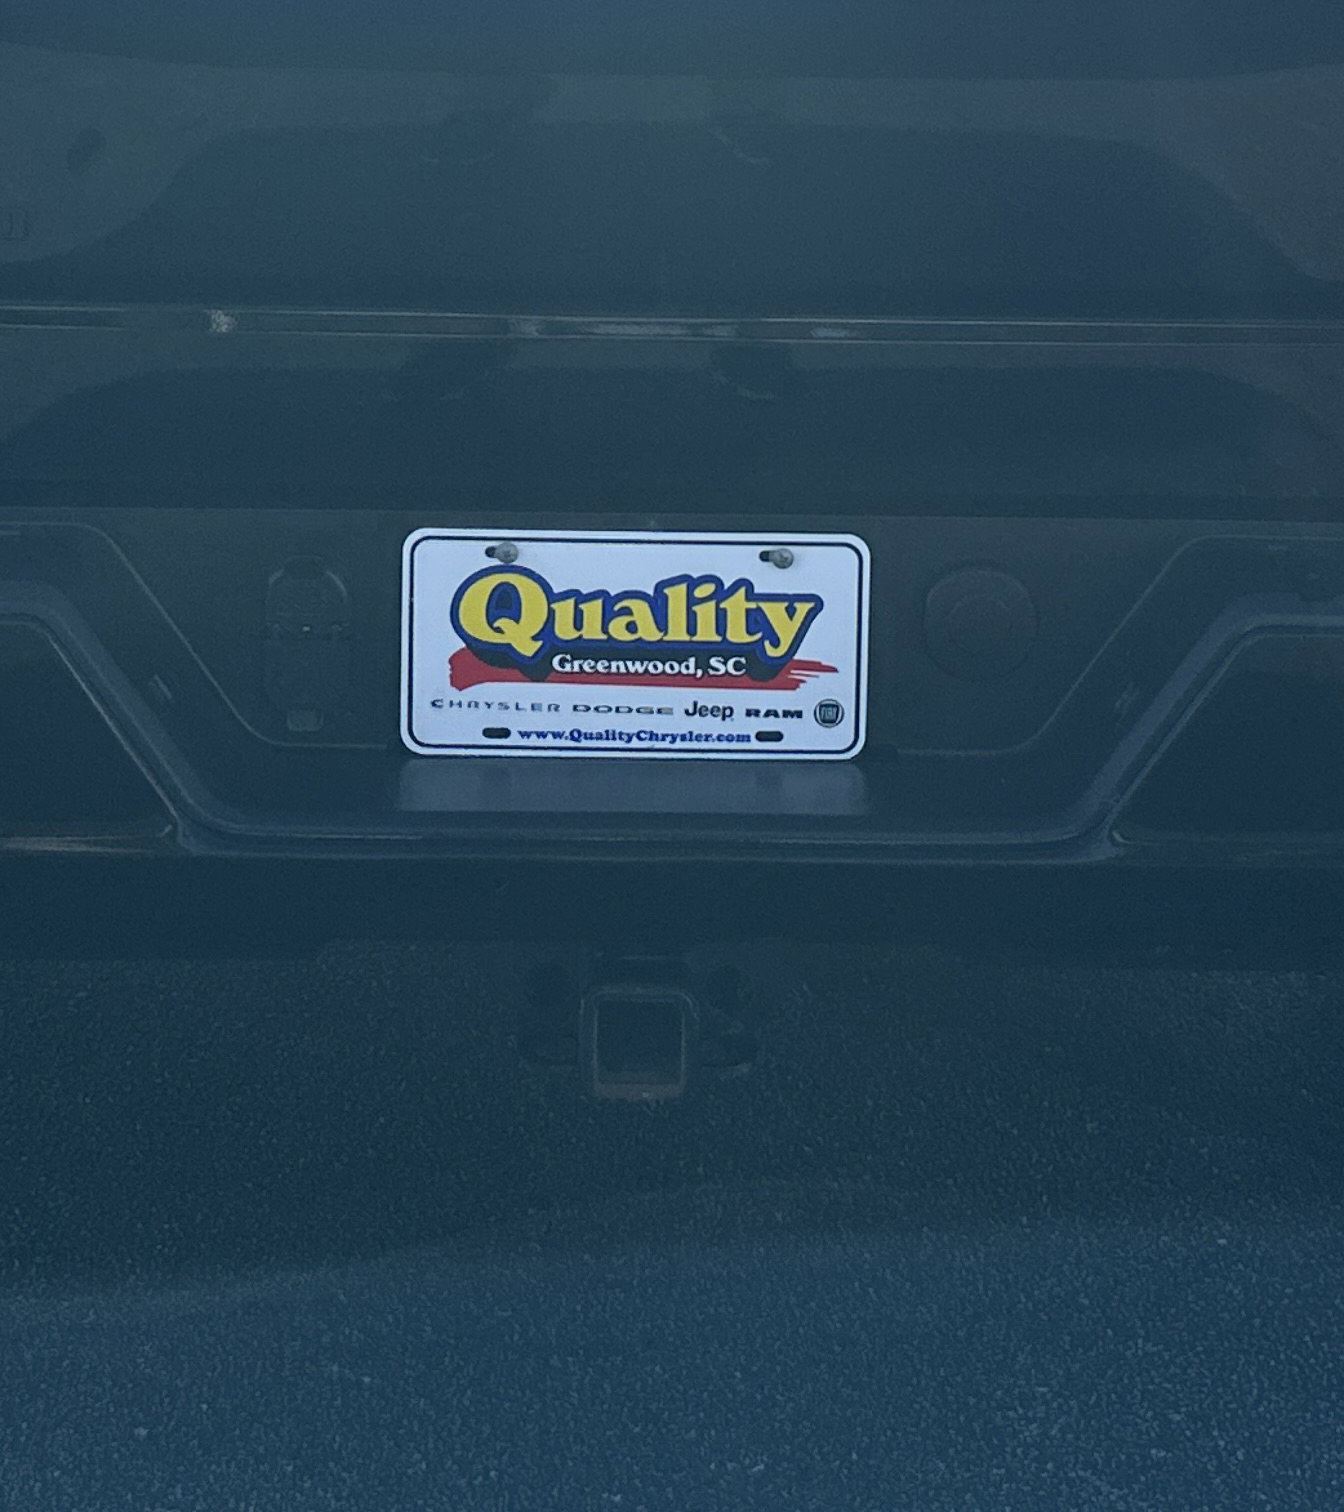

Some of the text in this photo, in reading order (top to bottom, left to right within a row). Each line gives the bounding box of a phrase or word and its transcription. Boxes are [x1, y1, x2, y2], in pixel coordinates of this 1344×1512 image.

[455, 569, 820, 660] Quality
[552, 654, 746, 678] Greenwood, SC
[430, 698, 561, 713] CHRYSLER
[572, 703, 674, 715] DODGE
[684, 700, 735, 722] Jeep
[744, 707, 804, 719] RAM
[517, 728, 751, 745] www.QualityChrysler.com
